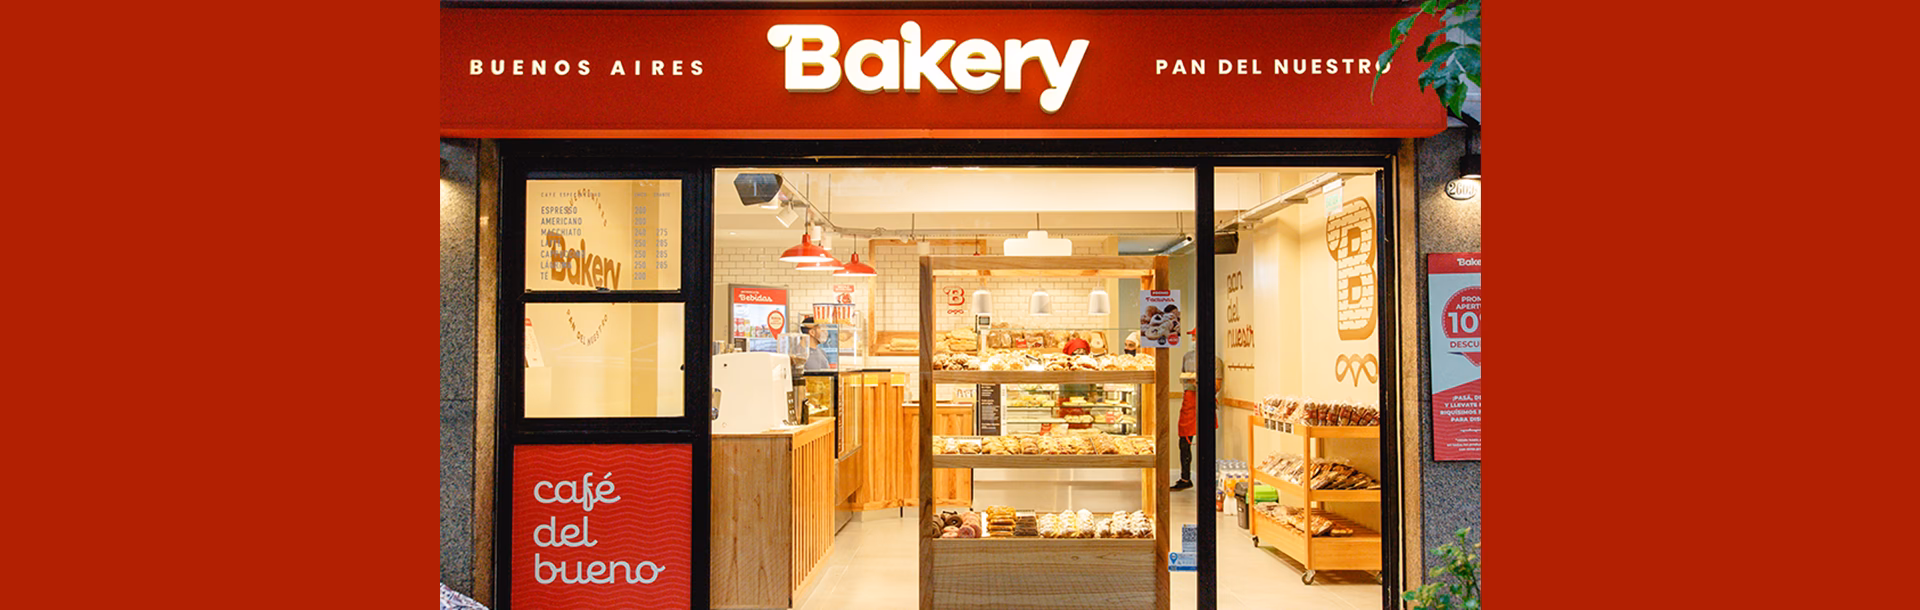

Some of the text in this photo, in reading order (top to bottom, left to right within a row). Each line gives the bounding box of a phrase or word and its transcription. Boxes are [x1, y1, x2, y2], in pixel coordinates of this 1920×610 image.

[469, 59, 704, 76] BUENOS AIRES
[767, 20, 1090, 113] Bakery
[1157, 58, 1206, 75] PAN
[1218, 58, 1262, 75] DEL
[540, 205, 578, 215] ESPRESSO
[540, 217, 583, 226] AMERICANO
[540, 228, 582, 237] MACCHIATO
[655, 228, 669, 237] 275
[540, 239, 562, 248] LATTE
[1227, 270, 1243, 300] pan
[738, 293, 773, 302] Bebidas
[1227, 296, 1240, 323] del
[1447, 311, 1481, 334] 10
[533, 471, 621, 512] café
[533, 516, 598, 548] del
[534, 553, 666, 585] bueno
